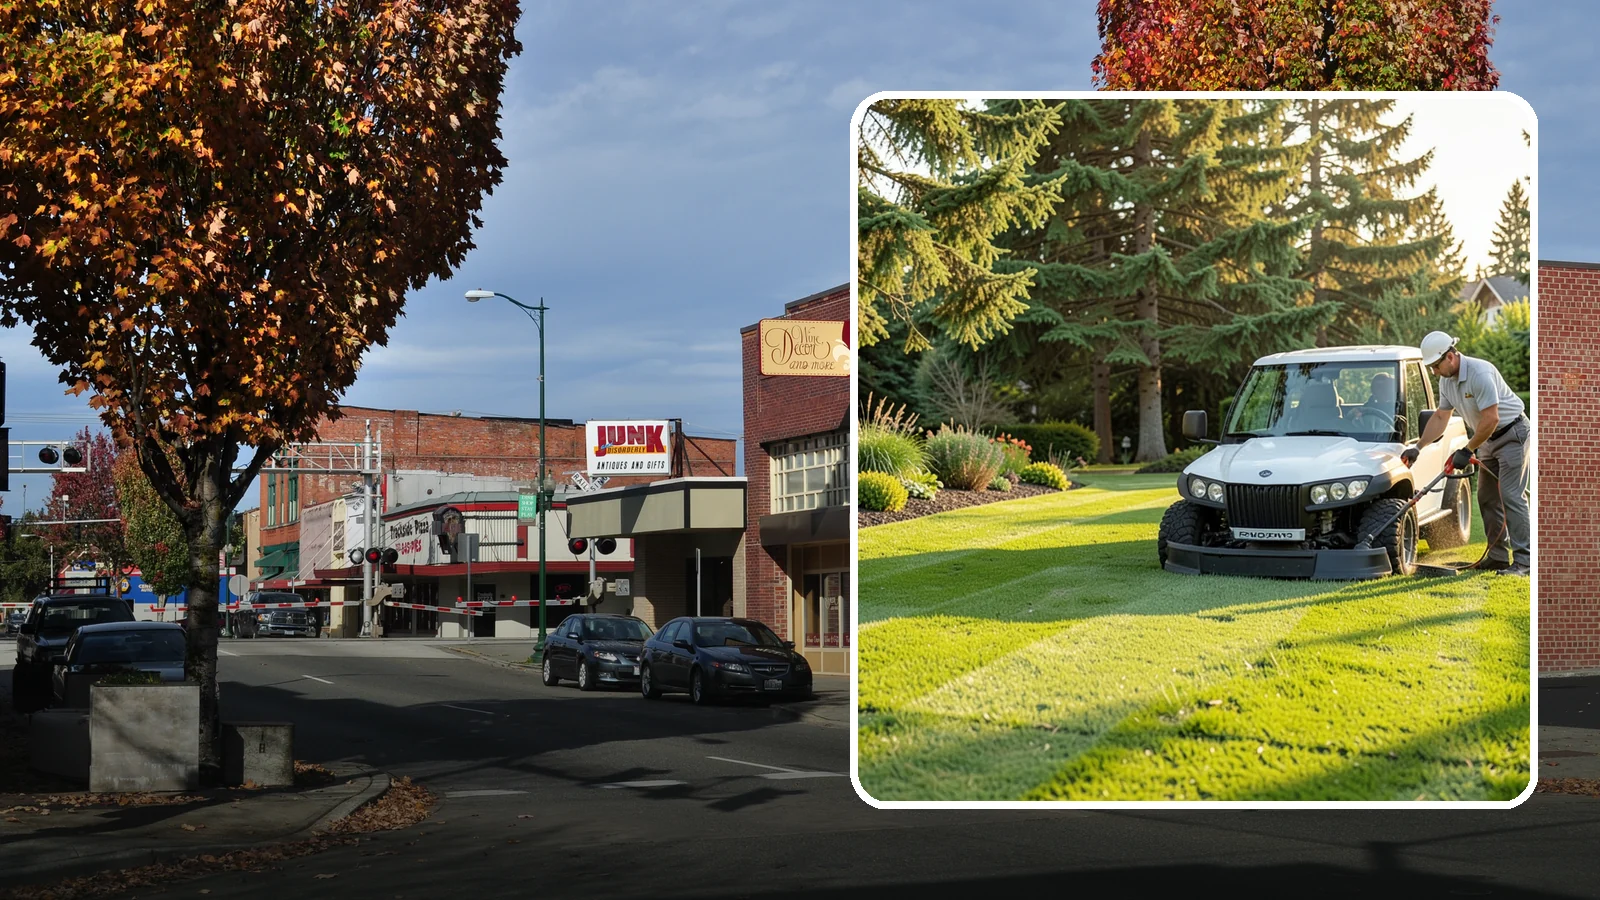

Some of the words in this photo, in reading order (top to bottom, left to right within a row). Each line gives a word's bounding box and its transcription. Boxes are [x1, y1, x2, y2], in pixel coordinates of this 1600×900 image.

[595, 425, 664, 457] JUNK
[607, 446, 646, 454] DISORDERLY
[597, 461, 628, 470] ANTIQUES
[631, 461, 644, 469] AND
[647, 461, 665, 469] GIFTS
